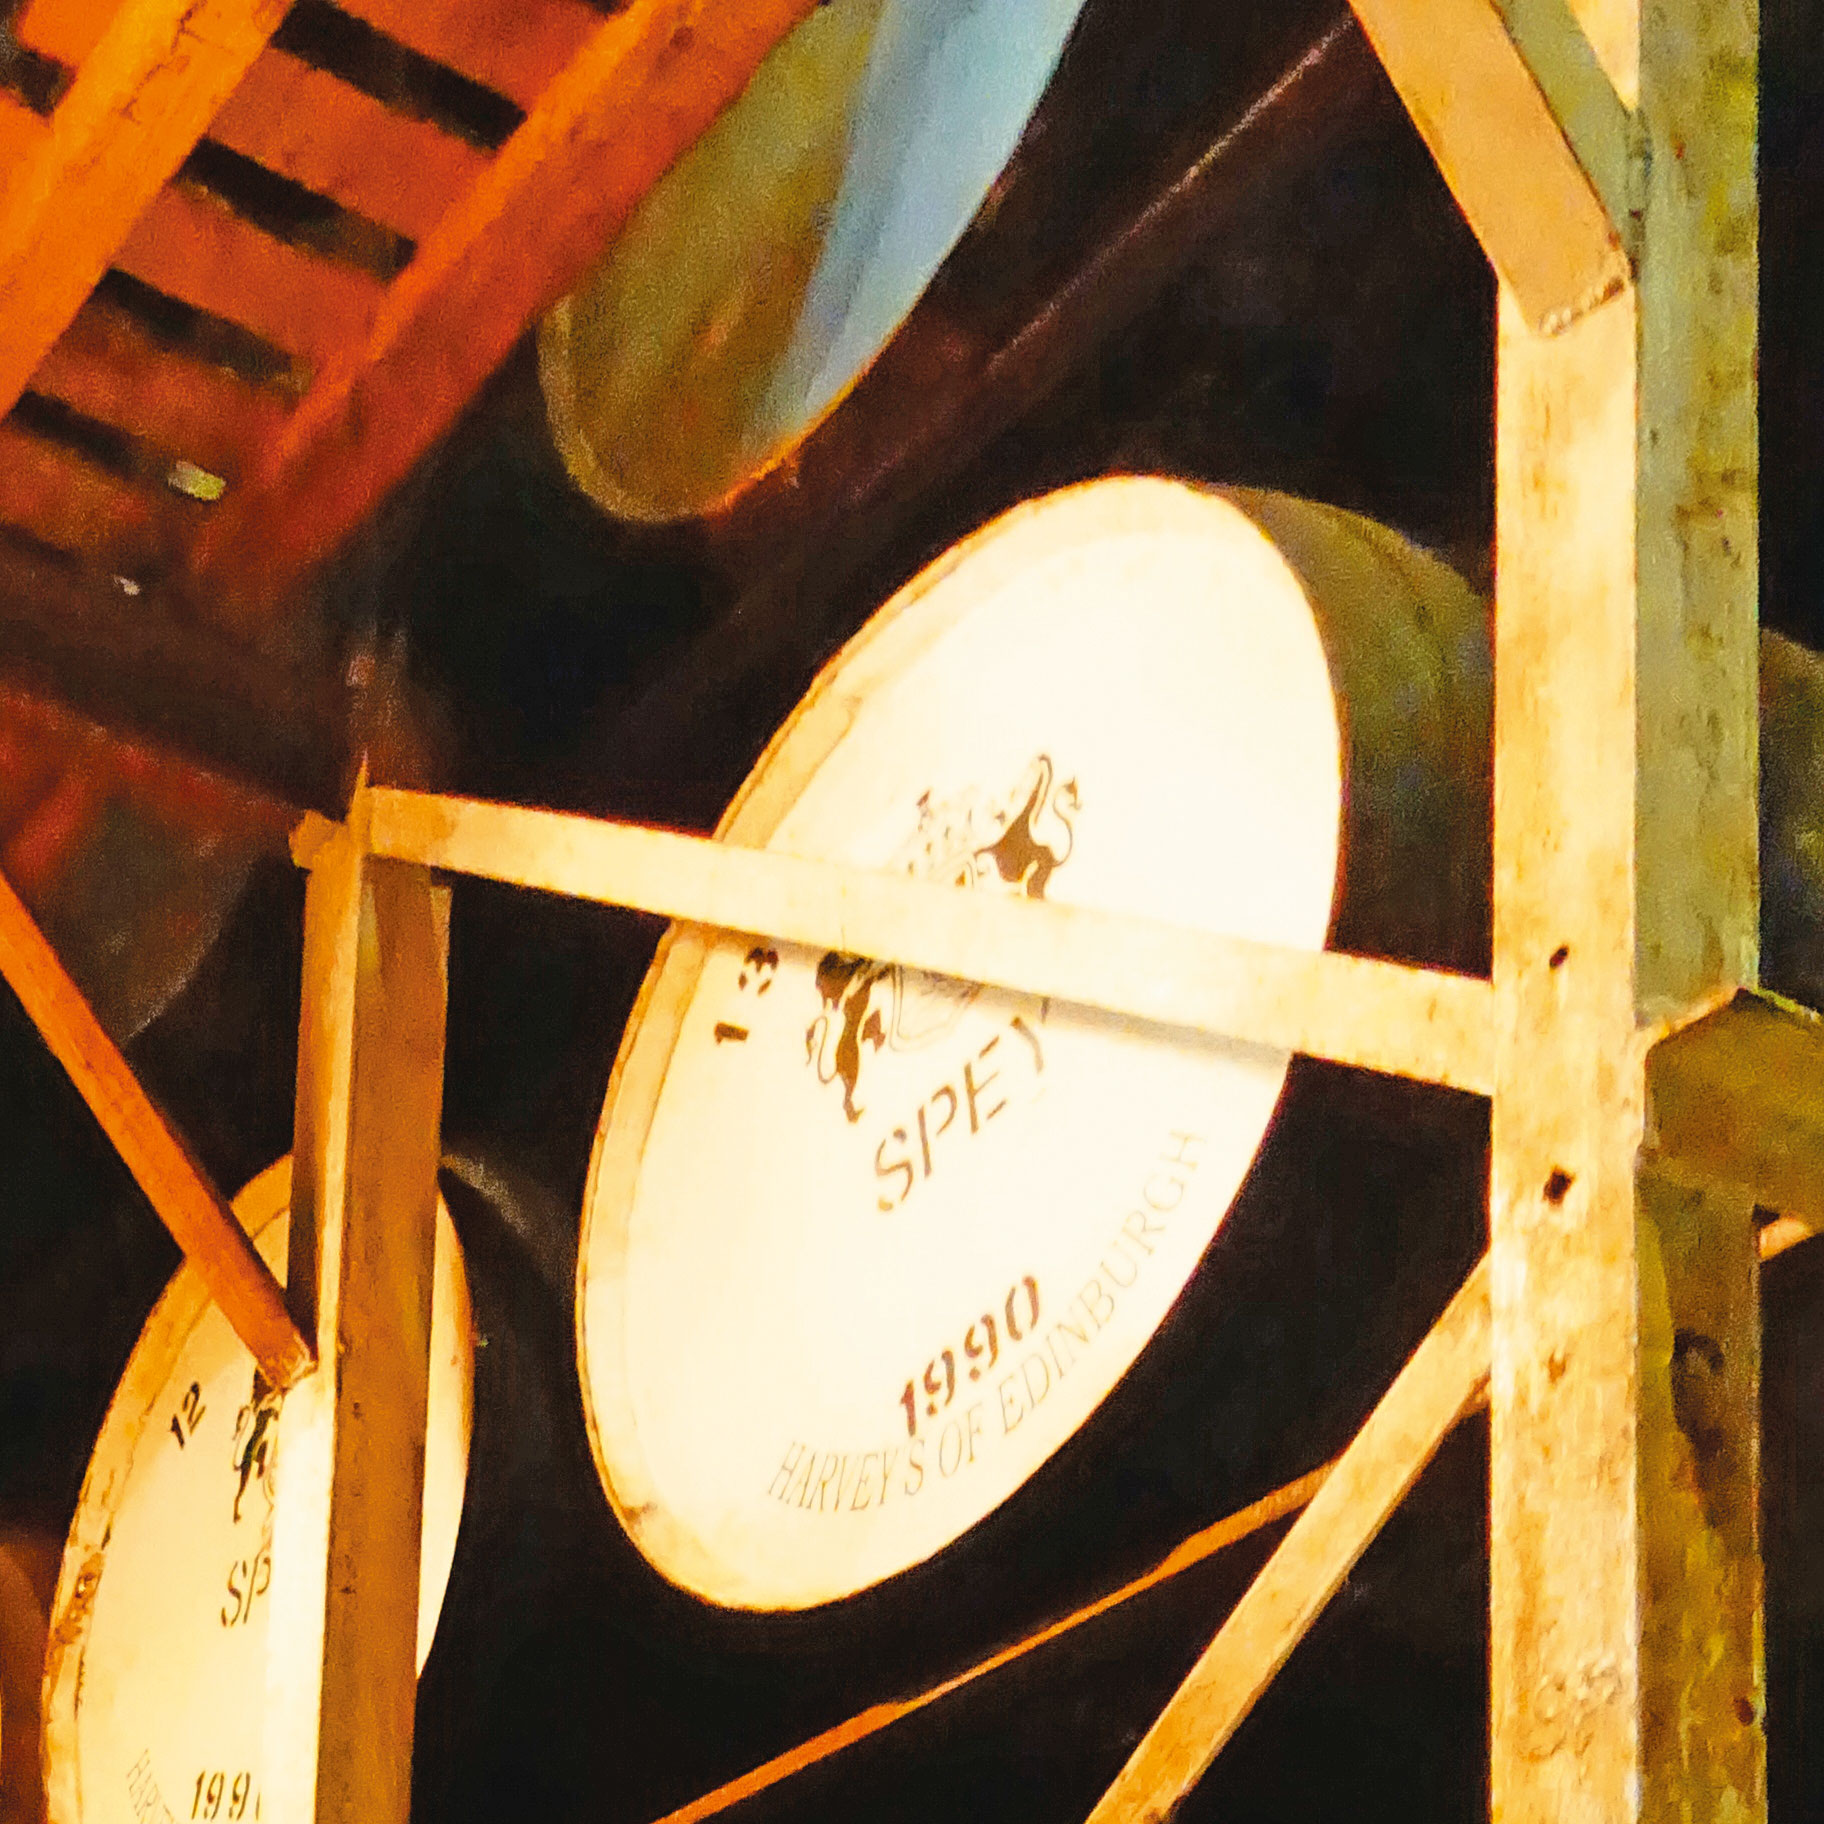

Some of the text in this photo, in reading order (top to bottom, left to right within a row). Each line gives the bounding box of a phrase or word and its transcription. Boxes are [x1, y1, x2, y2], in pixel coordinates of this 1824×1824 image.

[874, 997, 1051, 1212] SPEY
[900, 1274, 1040, 1437] 1990
[938, 1402, 984, 1478] OF
[997, 1129, 1207, 1436] EDINBURGH
[170, 1381, 207, 1450] 12
[222, 1552, 272, 1628] SP
